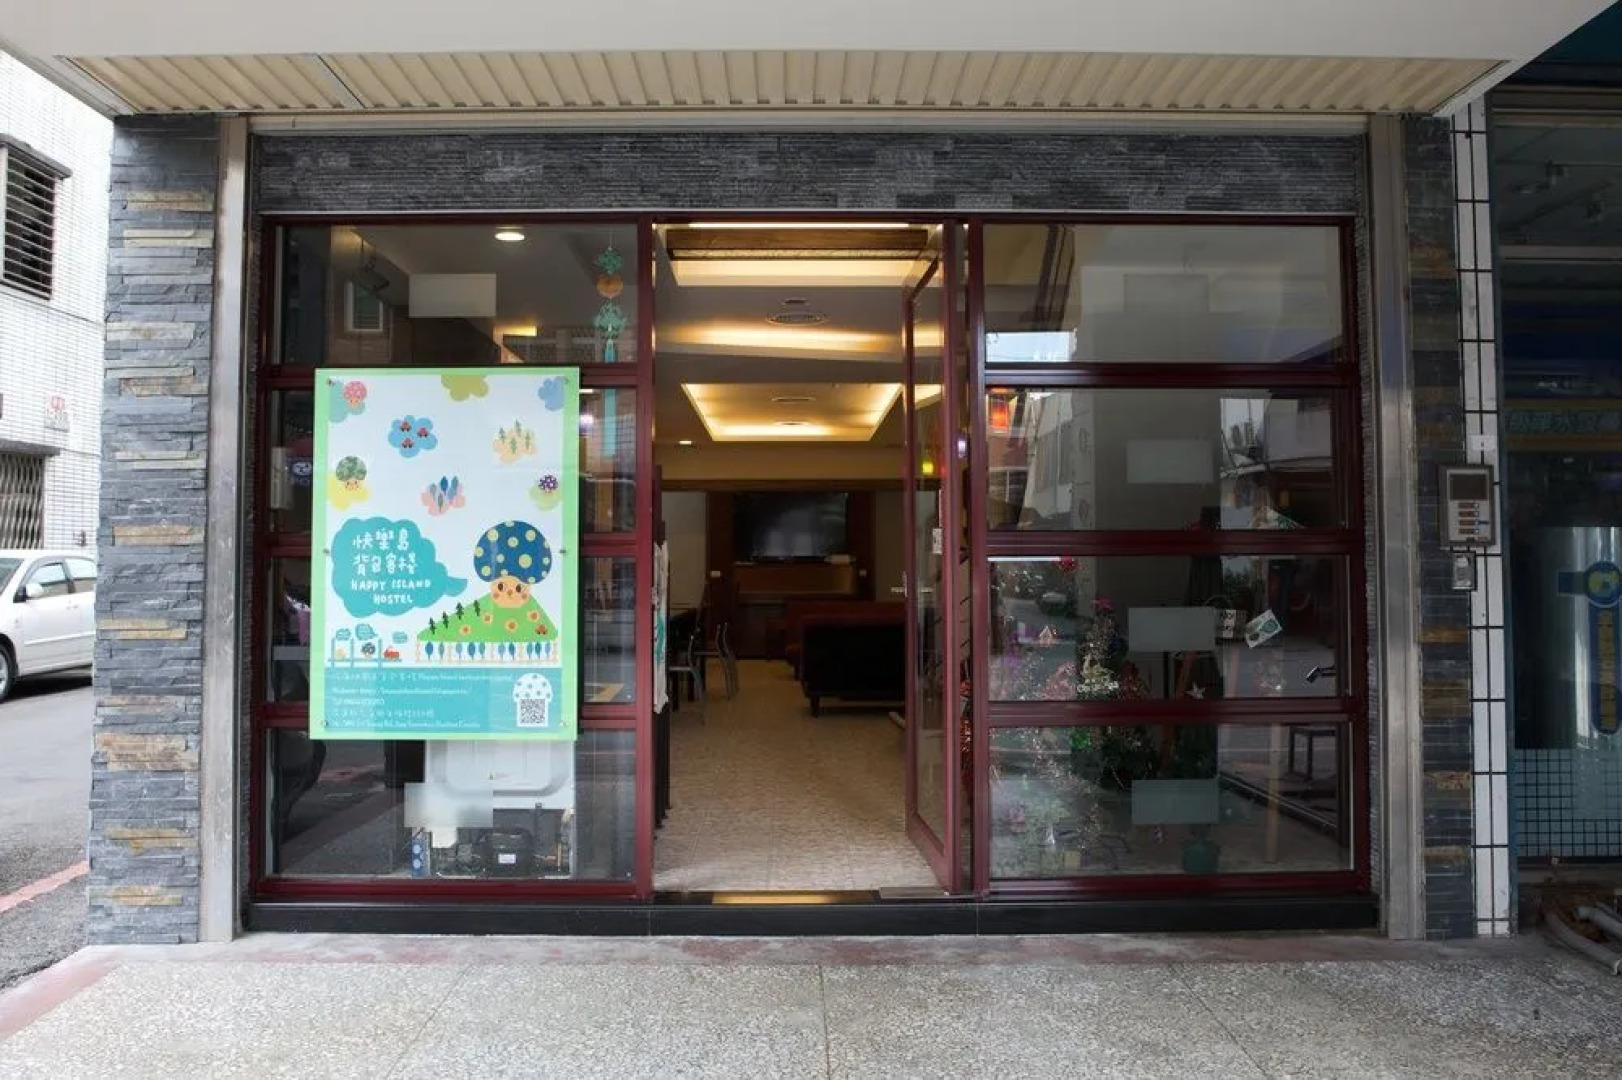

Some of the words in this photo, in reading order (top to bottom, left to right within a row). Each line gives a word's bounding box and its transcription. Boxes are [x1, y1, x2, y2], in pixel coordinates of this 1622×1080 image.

[352, 528, 409, 551] 快樂島
[351, 552, 418, 577] 背包客棧
[350, 578, 387, 591] HAPPY
[391, 579, 432, 590] ISLAND
[373, 594, 413, 606] HOSTEL
